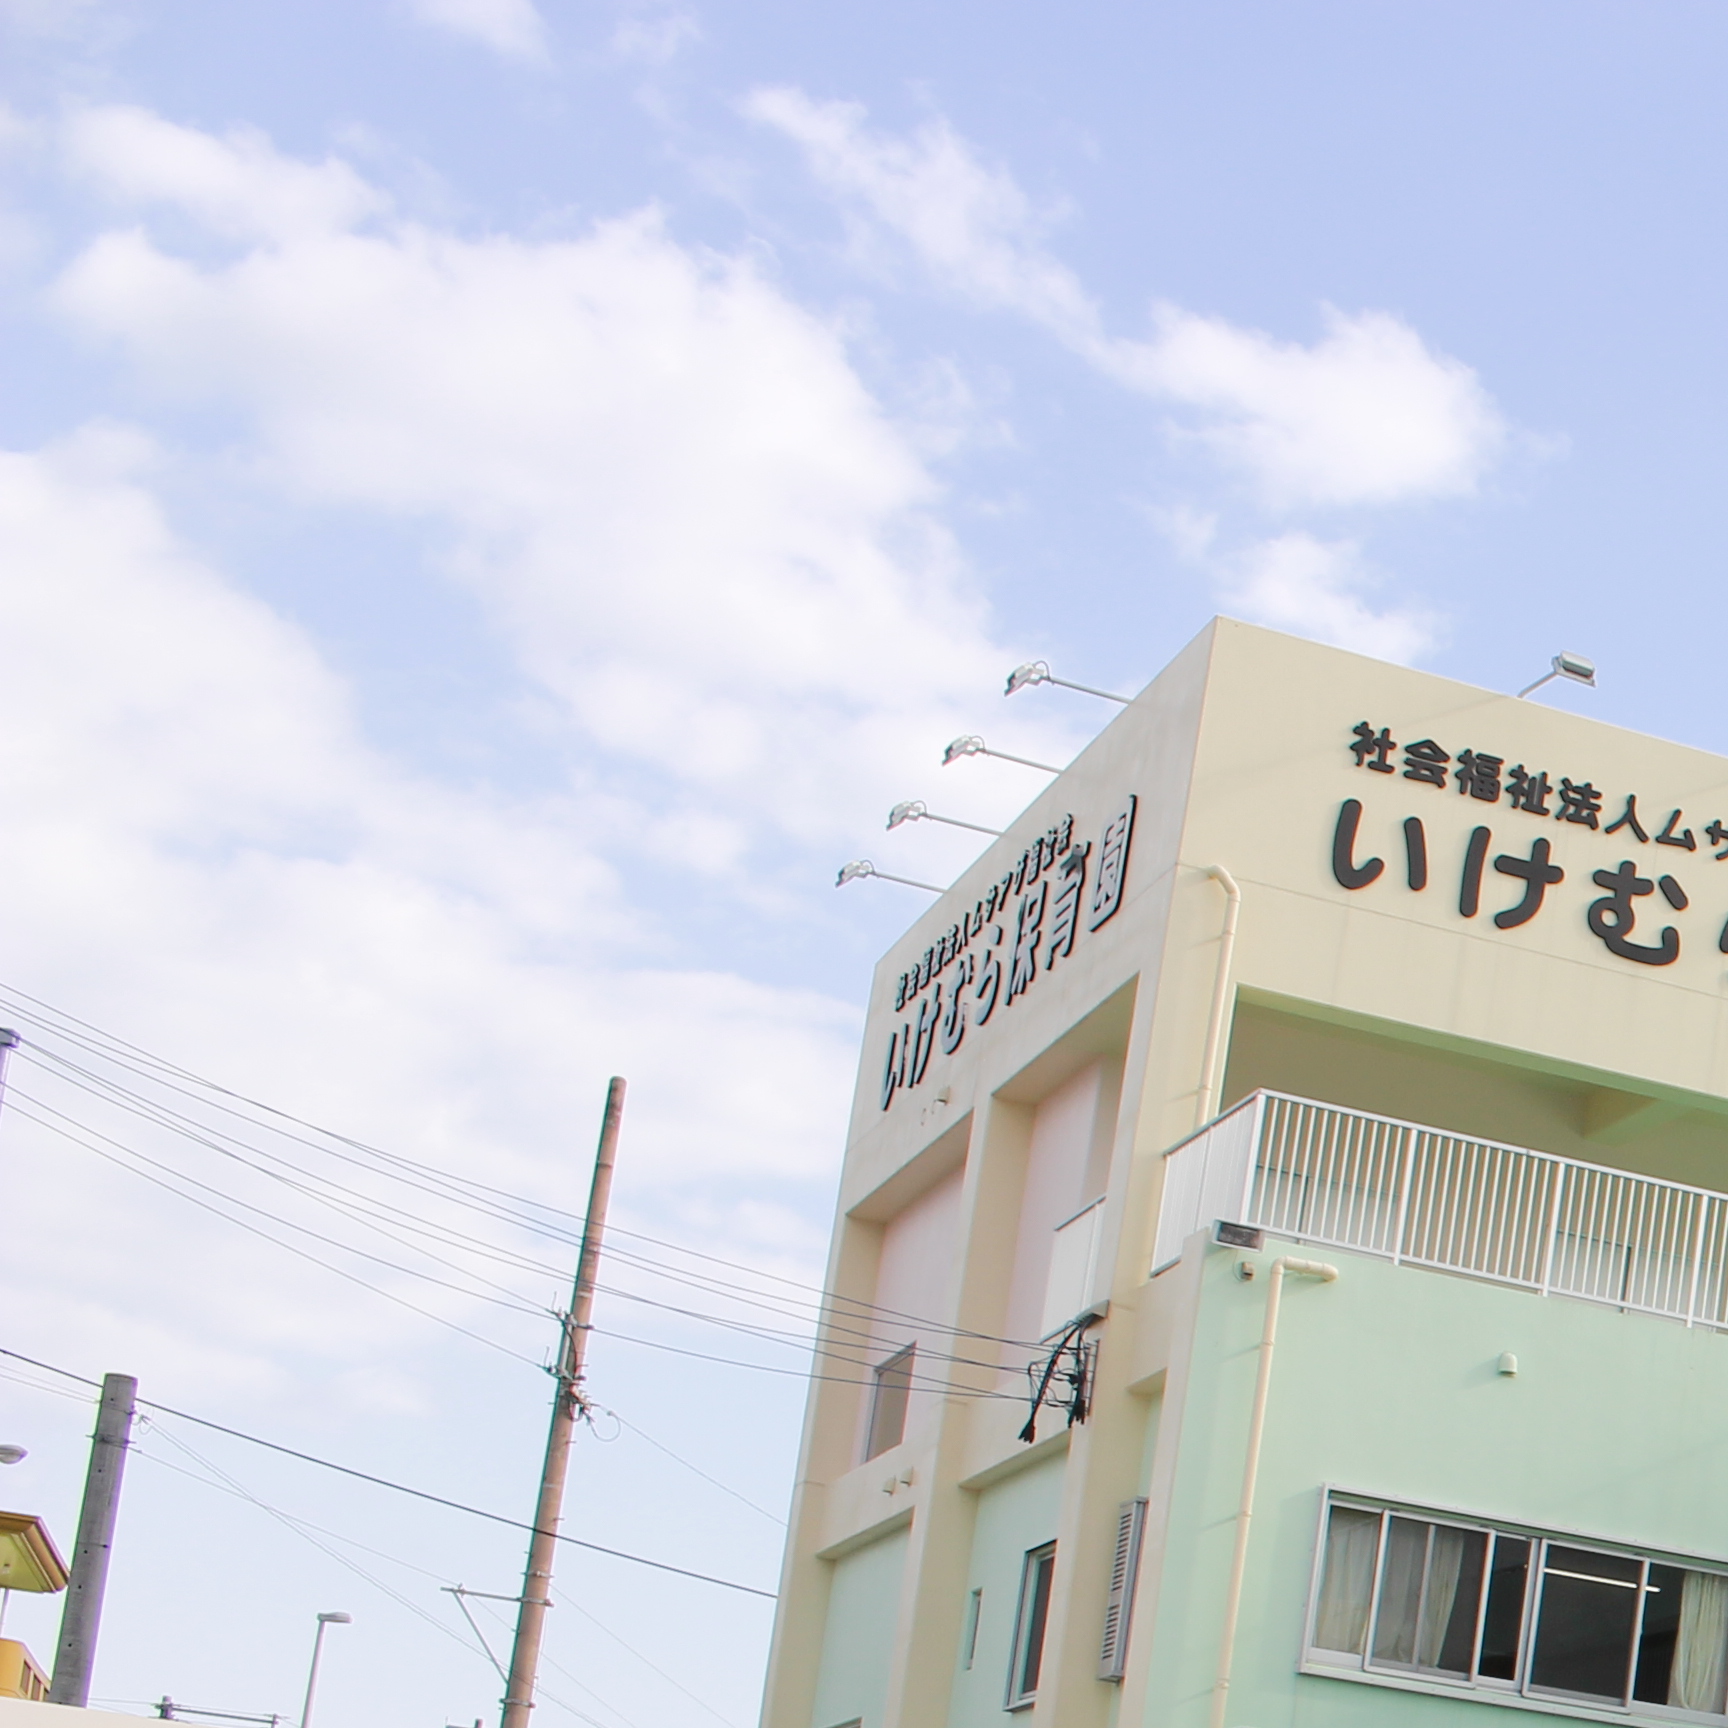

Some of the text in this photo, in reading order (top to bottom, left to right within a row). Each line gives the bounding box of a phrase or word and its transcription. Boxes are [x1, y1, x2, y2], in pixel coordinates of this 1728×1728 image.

[880, 794, 1139, 1112] いけむら保育園
